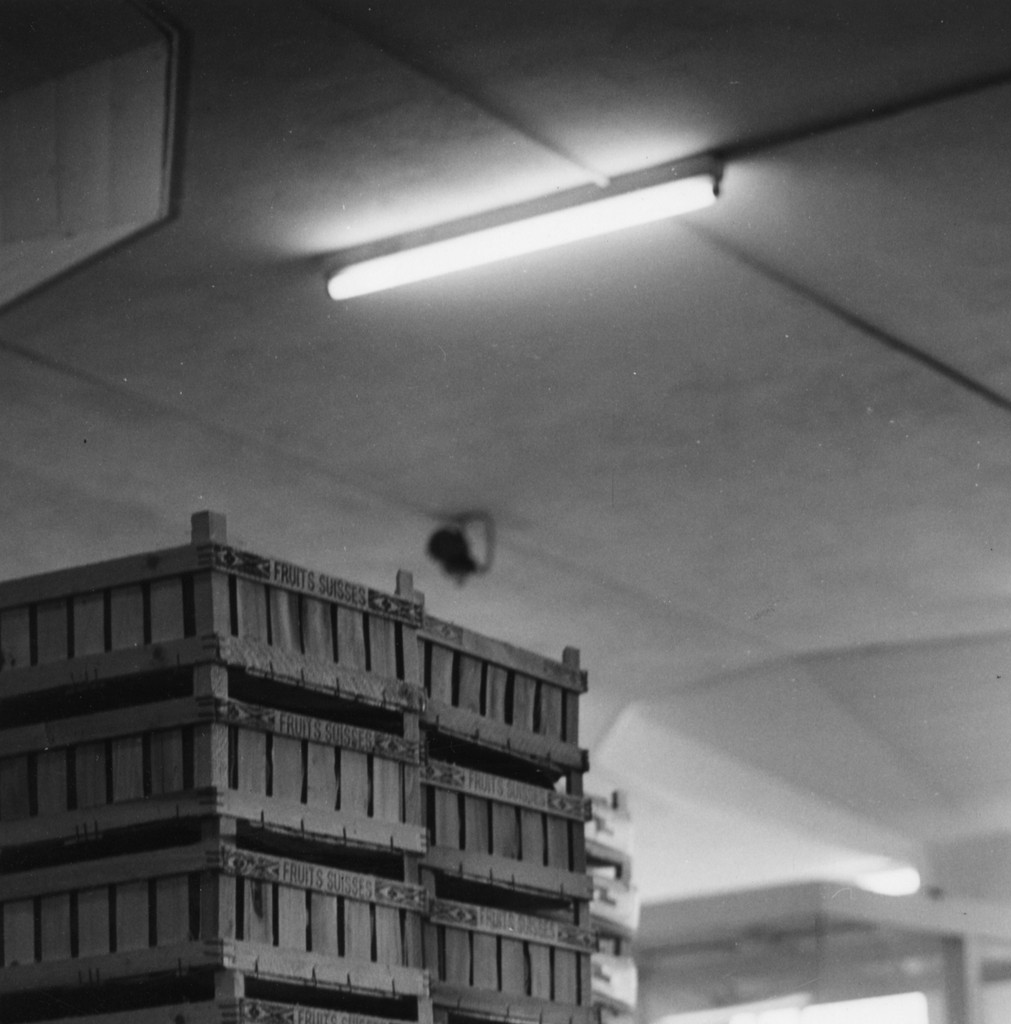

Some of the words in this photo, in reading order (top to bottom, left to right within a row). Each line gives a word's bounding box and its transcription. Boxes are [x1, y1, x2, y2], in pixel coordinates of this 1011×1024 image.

[274, 561, 316, 591] FRUITS
[319, 575, 367, 606] SUISSES
[279, 715, 321, 739] FRUITS
[325, 724, 374, 749] SUISSES
[468, 772, 503, 795] FRUITS
[506, 781, 546, 807] SUISSES
[282, 861, 324, 886] FRUITS
[326, 871, 373, 897] SUISSES
[480, 911, 517, 931] FRUITS
[519, 919, 556, 939] SUISSES
